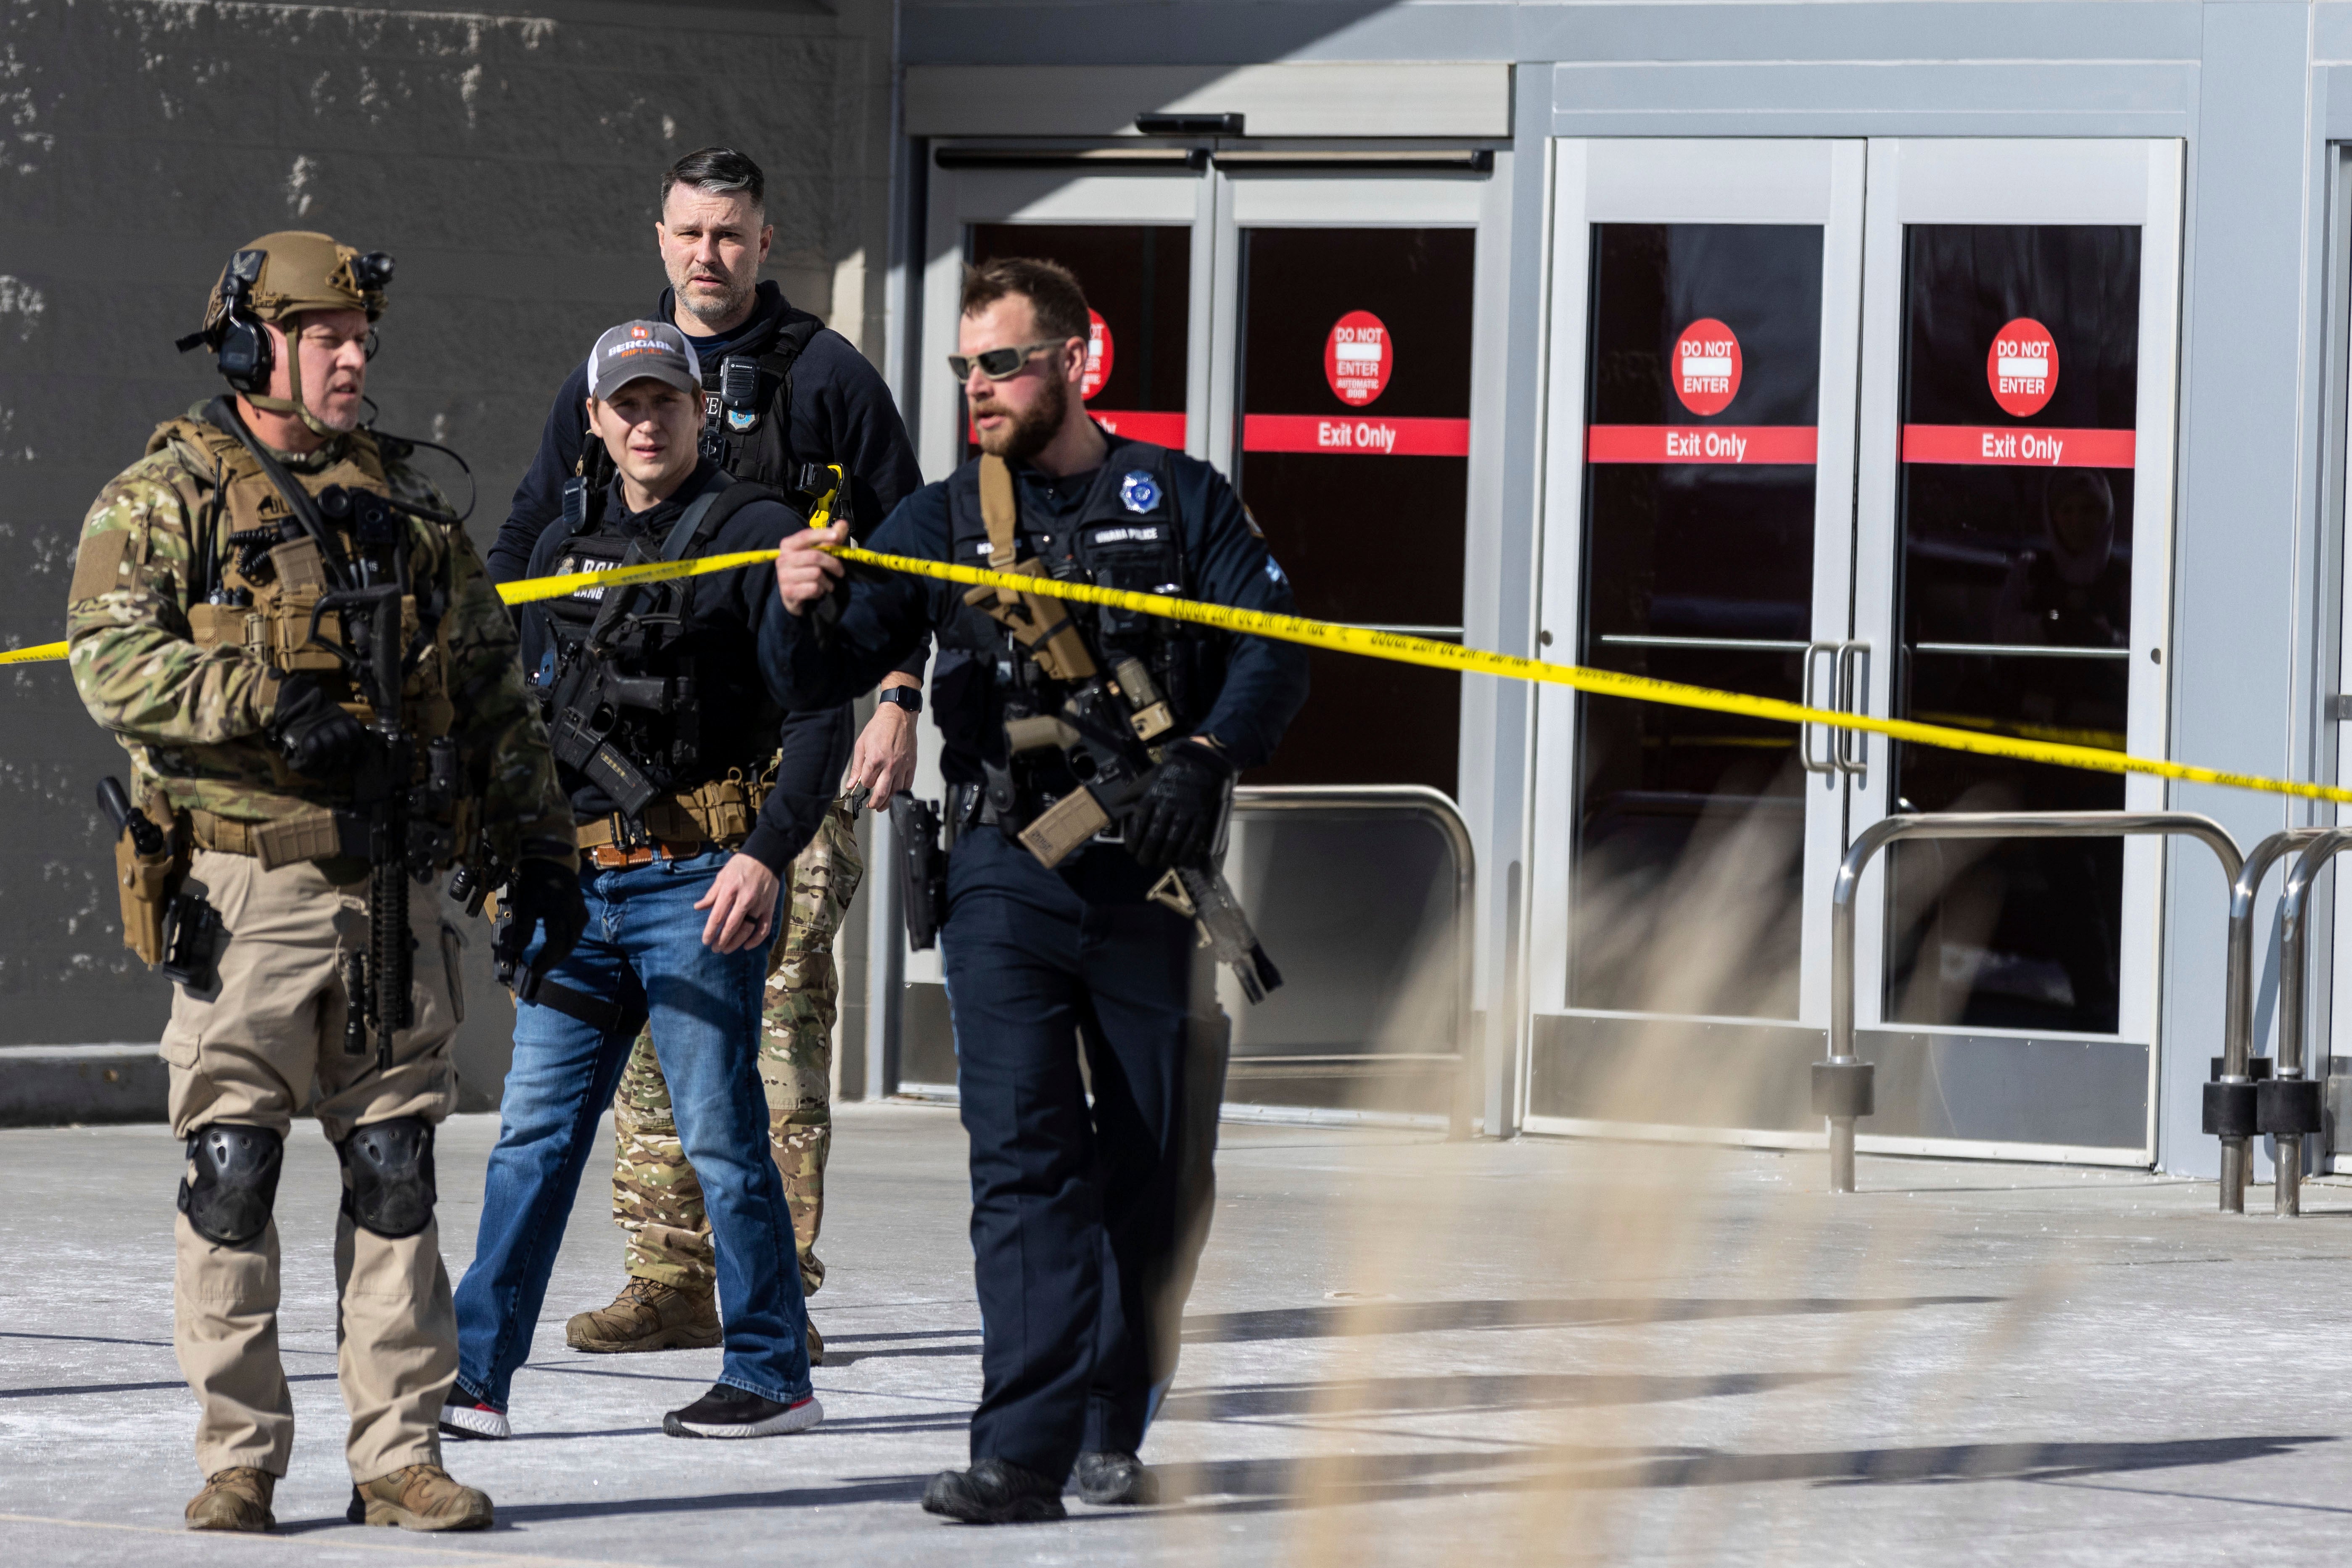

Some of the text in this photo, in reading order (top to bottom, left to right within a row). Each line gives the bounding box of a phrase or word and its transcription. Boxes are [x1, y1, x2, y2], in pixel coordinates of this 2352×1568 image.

[1336, 327, 1383, 343] DO NOT
[1682, 341, 1733, 357] DO NOT
[1998, 340, 2050, 358] DO NOT
[1337, 361, 1378, 377] ENTER
[1336, 379, 1379, 389] AUTOMATIC
[1684, 377, 1729, 393] ENTER
[1999, 378, 2045, 394] ENTER
[1346, 389, 1367, 399] DOOR
[1318, 422, 1396, 453] Exit Only
[1667, 432, 1747, 462] Exit Only
[1982, 433, 2063, 465] Exit Only
